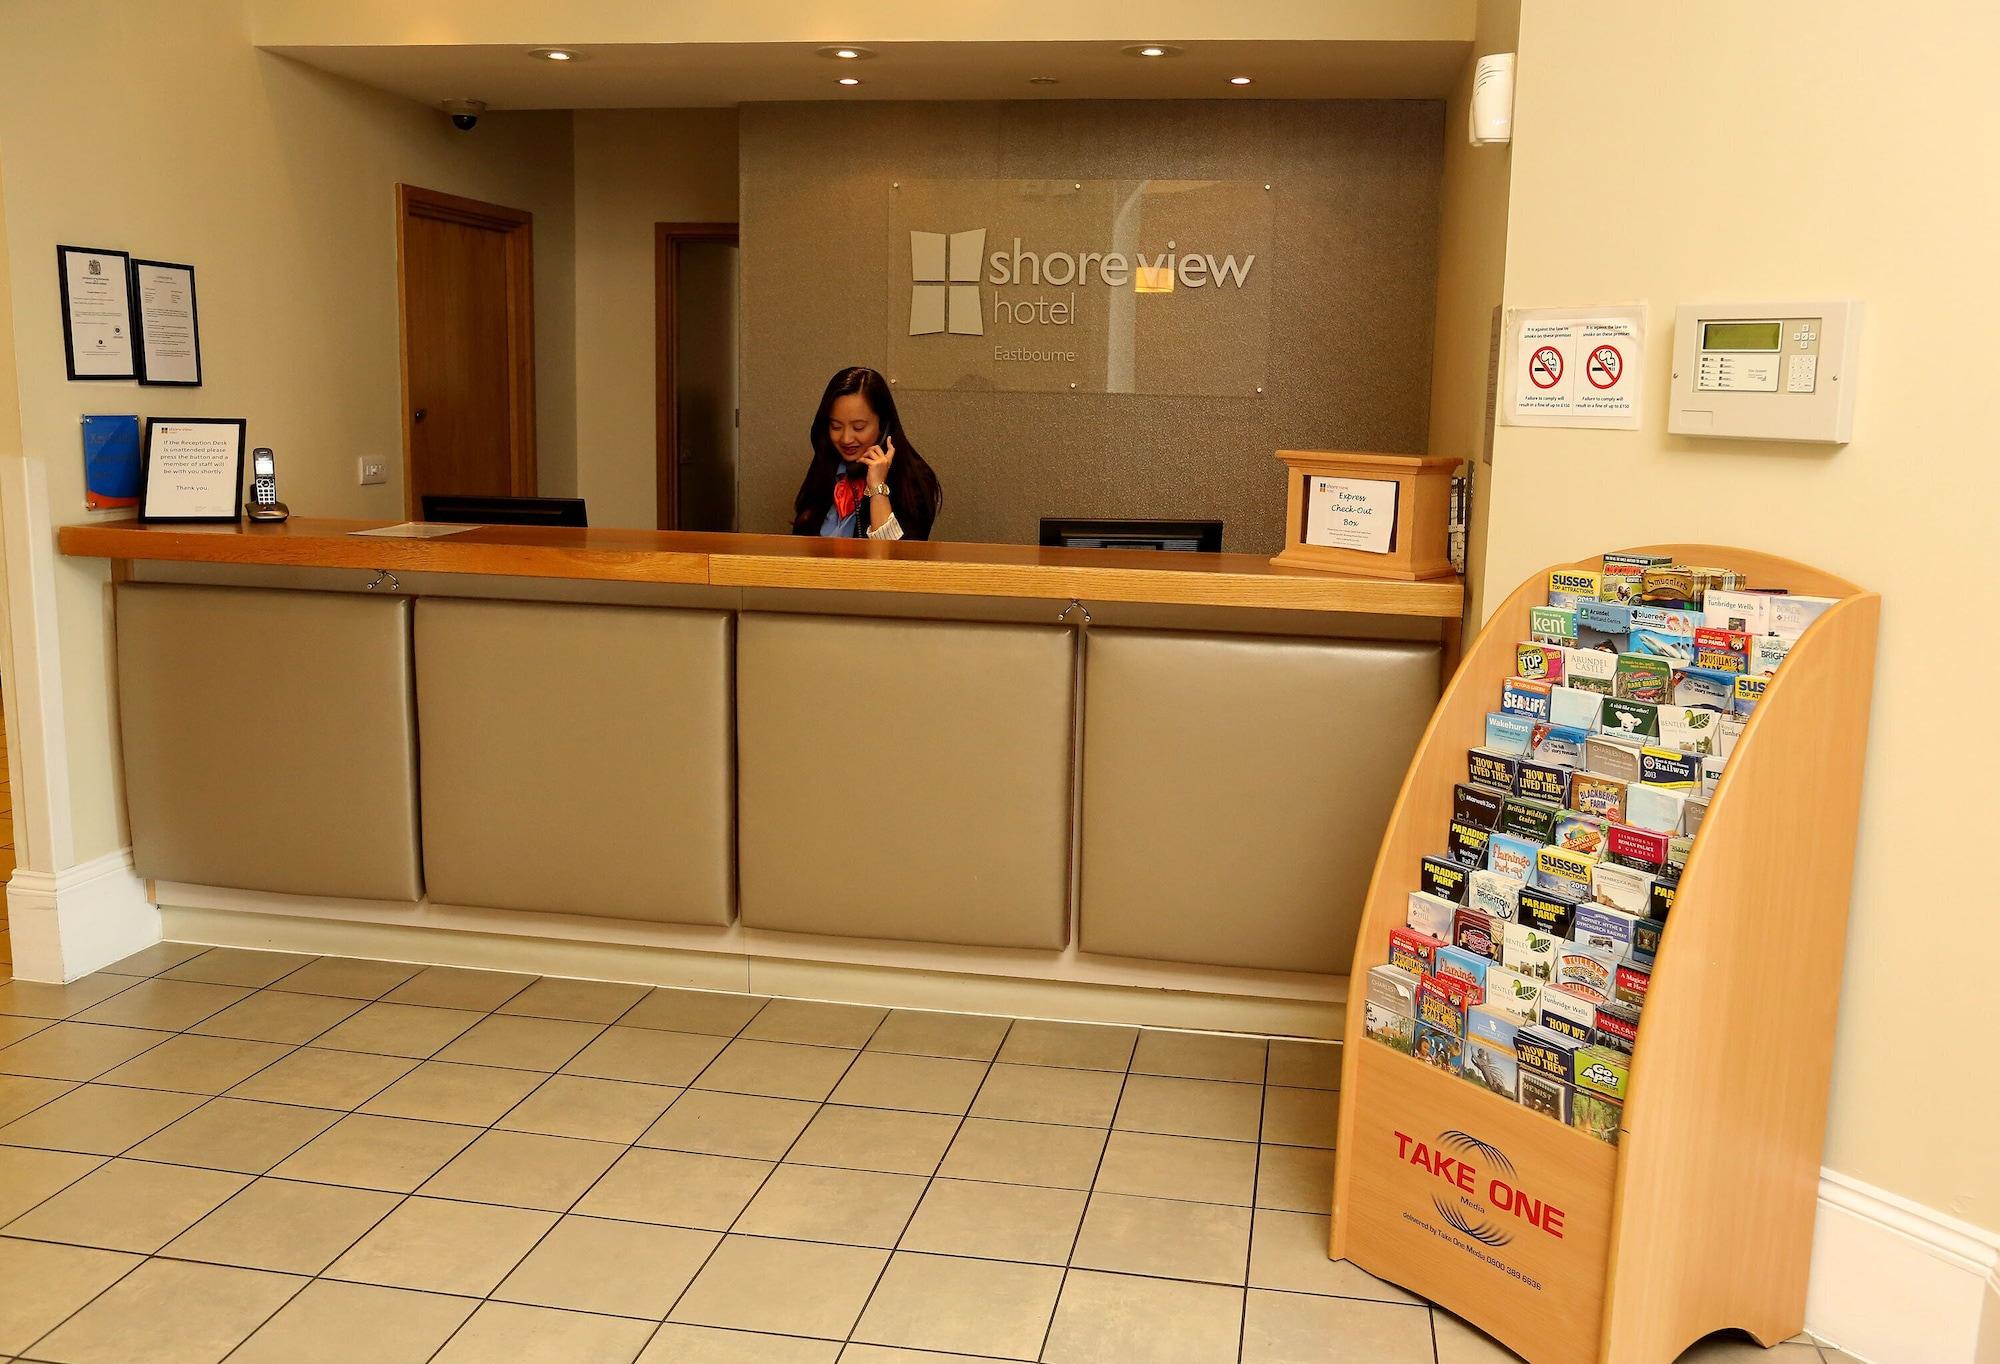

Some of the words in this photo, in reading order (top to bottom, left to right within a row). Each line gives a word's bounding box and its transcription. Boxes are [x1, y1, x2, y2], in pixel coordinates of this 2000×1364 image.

[989, 238, 1129, 287] shore
[1136, 240, 1256, 289] view
[993, 290, 1076, 326] hotel
[994, 345, 1076, 363] Eastbourne
[1338, 492, 1367, 502] Express
[1331, 504, 1373, 515] Check-Out
[1343, 519, 1360, 527] Box
[1552, 574, 1594, 588] sussex
[1562, 586, 1594, 594] ATTRACTIONS
[1589, 608, 1610, 617] Arundel
[1708, 600, 1737, 610] Tunbridge
[1738, 603, 1754, 612] Wells
[1533, 610, 1566, 634] kent
[1520, 655, 1544, 670] TOP
[1570, 654, 1609, 668] ARUNDEL
[1576, 664, 1605, 674] CASTLE
[1489, 718, 1529, 733] Wakehurst
[1470, 764, 1491, 778] LIVED
[1494, 760, 1506, 772] WE
[1655, 763, 1690, 777] Railway
[1545, 772, 1557, 784] WE
[1644, 770, 1657, 779] 2013
[1520, 777, 1541, 790] LIVED
[1580, 788, 1618, 804] BLACKBERRY
[1507, 804, 1526, 814] British
[1590, 798, 1606, 809] FARM
[1452, 822, 1489, 841] PARADISE
[1459, 834, 1480, 848] PARK
[1618, 838, 1636, 848] ROMAN
[1492, 843, 1530, 868] Flamingo
[1624, 846, 1655, 859] GARDENS
[1424, 862, 1463, 882] PARADISE
[1540, 854, 1588, 876] sussex
[1432, 874, 1454, 888] PARK
[1552, 868, 1588, 883] ATTRACTIONS
[1570, 880, 1588, 891] 2013
[1476, 890, 1511, 909] BRIGHTON
[1521, 896, 1566, 916] PARADISE
[1532, 908, 1556, 922] PARK
[1568, 956, 1604, 975] TULLEYS
[1544, 996, 1571, 1009] Tunbridge
[1572, 1004, 1588, 1017] Wells
[1572, 1027, 1586, 1040] WE
[1517, 1050, 1541, 1066] LIVED
[1546, 1050, 1560, 1064] WE
[1581, 1067, 1619, 1086] Ape!
[1591, 1063, 1612, 1078] Go
[1394, 1130, 1476, 1194] TAKE
[1488, 1178, 1566, 1240] ONE
[1460, 1196, 1486, 1214] Media
[1402, 1212, 1429, 1230] delivered
[1429, 1224, 1438, 1236] by
[1438, 1229, 1452, 1243] Take
[1453, 1237, 1466, 1250] One
[1466, 1244, 1486, 1261] Media
[1486, 1256, 1506, 1272] 0800
